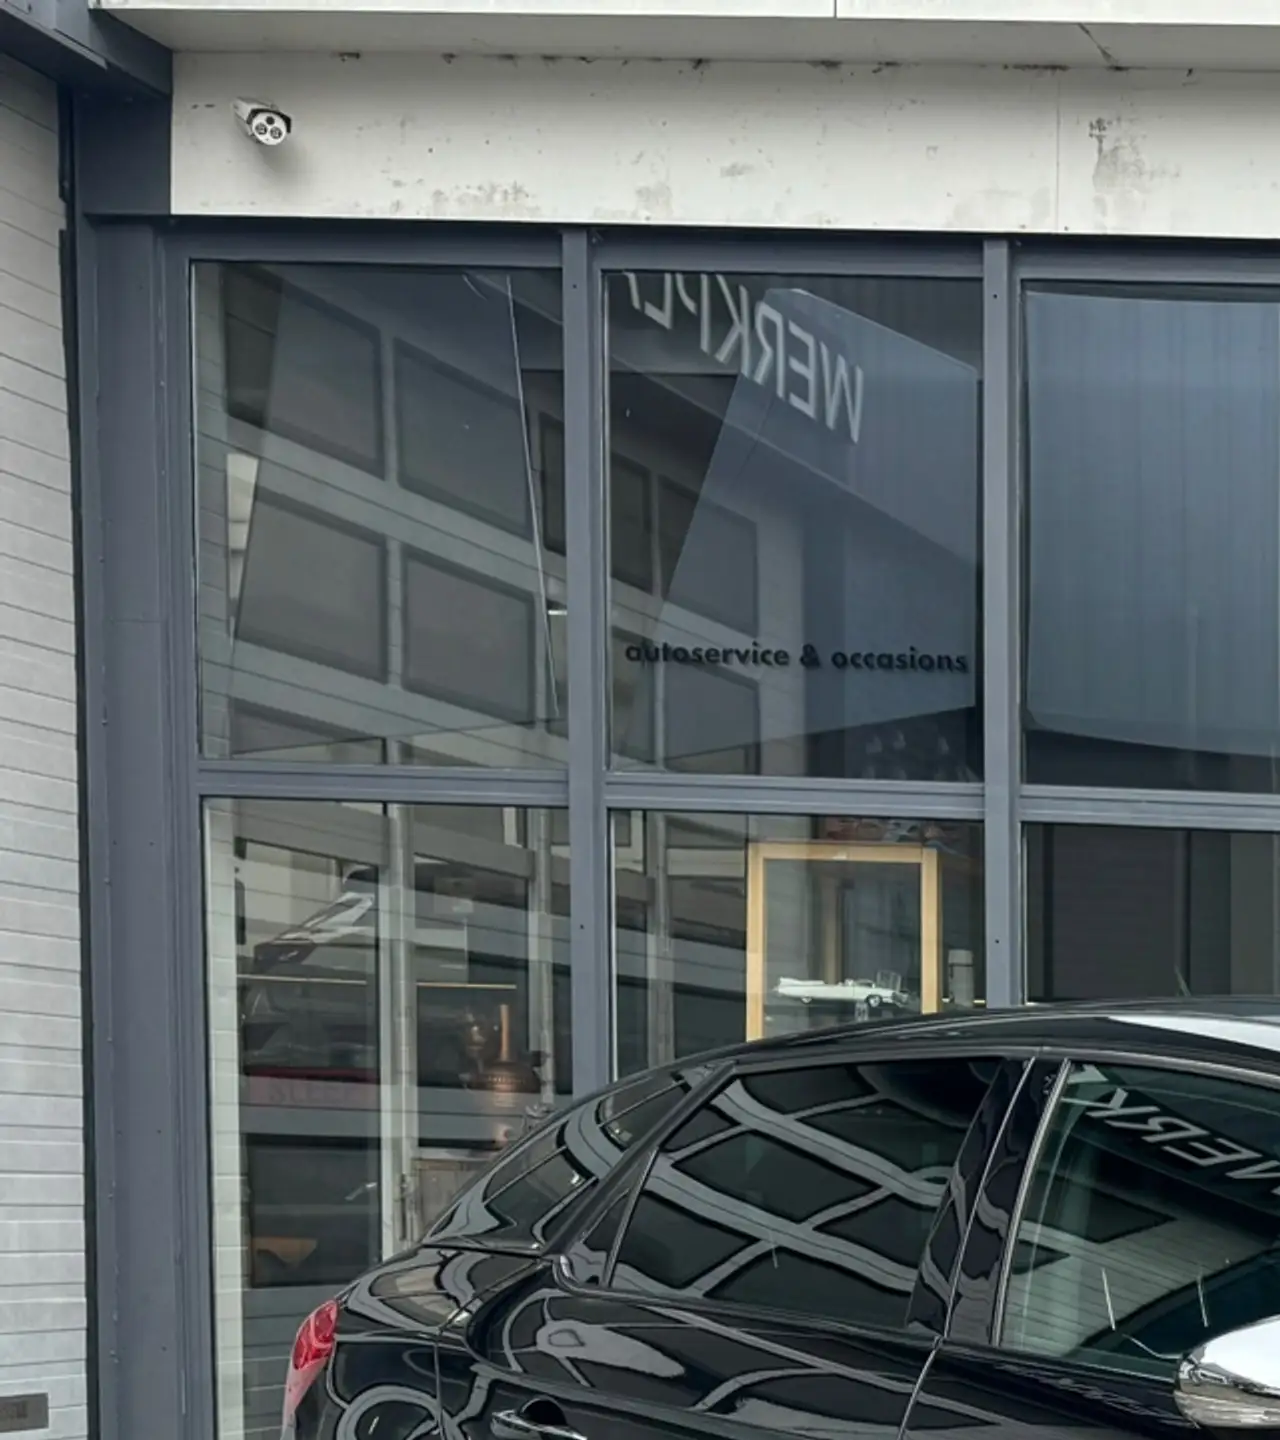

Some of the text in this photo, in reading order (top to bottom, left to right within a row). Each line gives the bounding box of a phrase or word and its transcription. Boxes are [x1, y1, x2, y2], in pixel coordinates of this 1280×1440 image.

[625, 641, 970, 674] autoservice & occasions
